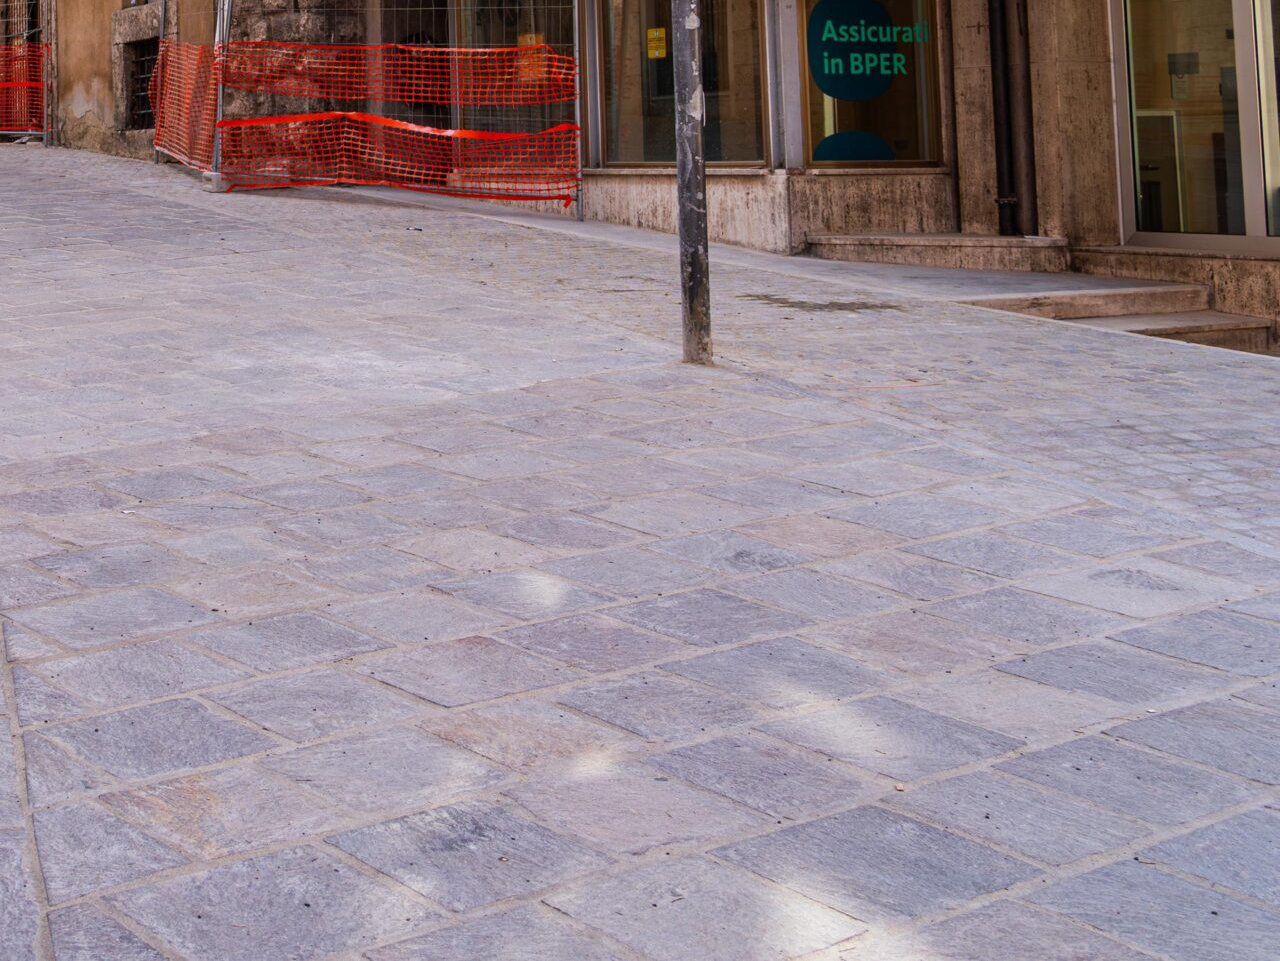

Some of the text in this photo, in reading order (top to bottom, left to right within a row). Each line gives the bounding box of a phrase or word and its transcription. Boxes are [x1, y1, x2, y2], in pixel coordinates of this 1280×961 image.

[821, 19, 929, 44] Assicurati
[823, 51, 908, 75] in BPER
